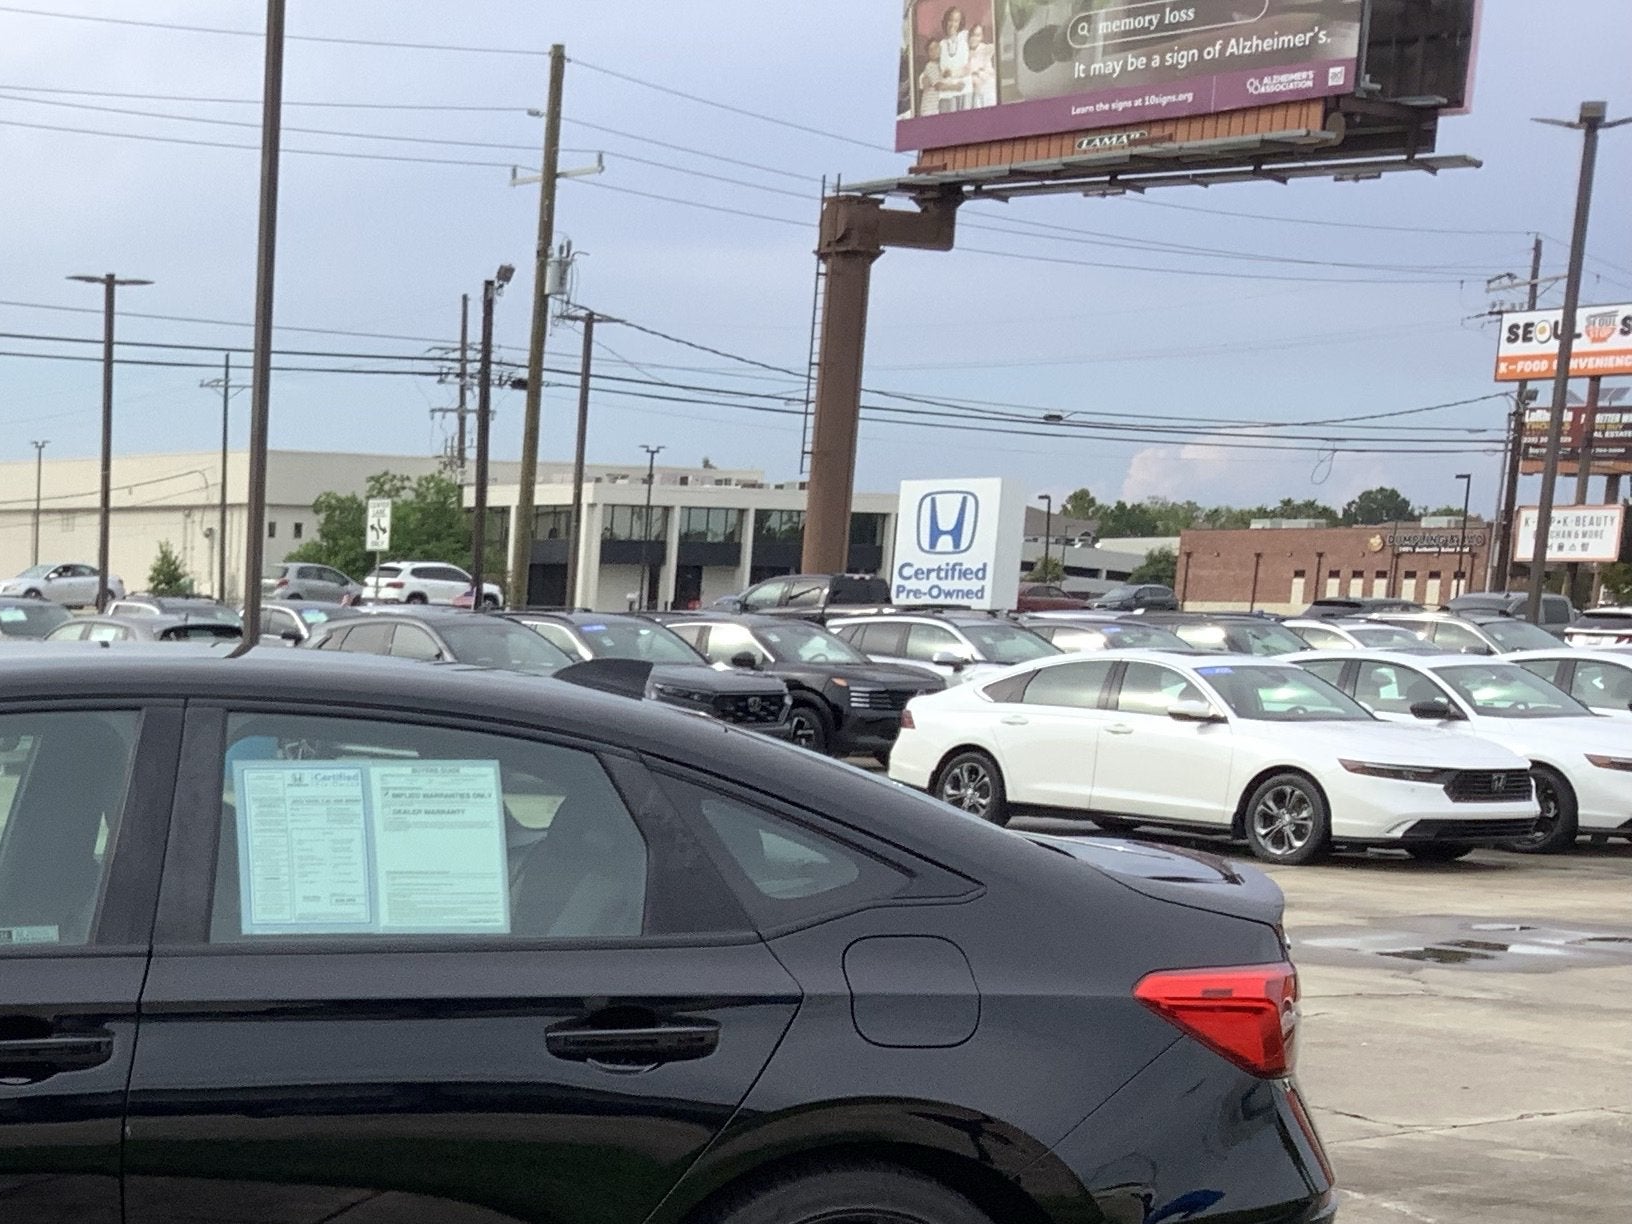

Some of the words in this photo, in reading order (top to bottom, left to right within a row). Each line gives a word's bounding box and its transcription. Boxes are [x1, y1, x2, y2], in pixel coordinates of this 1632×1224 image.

[1099, 14, 1160, 34] memory
[1165, 7, 1196, 24] loss
[1074, 62, 1086, 78] It
[1090, 60, 1123, 78] may
[1127, 54, 1147, 71] be
[1151, 54, 1160, 67] a
[1165, 46, 1199, 69] sign
[1203, 40, 1223, 60] of
[1225, 26, 1332, 57] Alzheimer's.
[1260, 80, 1314, 93] ASSOCIATION
[1071, 105, 1094, 116] Learn
[1095, 101, 1110, 112] the
[1111, 99, 1133, 111] signs
[1133, 97, 1143, 107] at
[1144, 91, 1194, 107] 10signs.org
[1498, 359, 1549, 373] K-FOOD
[898, 562, 988, 581] Certified
[895, 584, 985, 600] Pre-Owned
